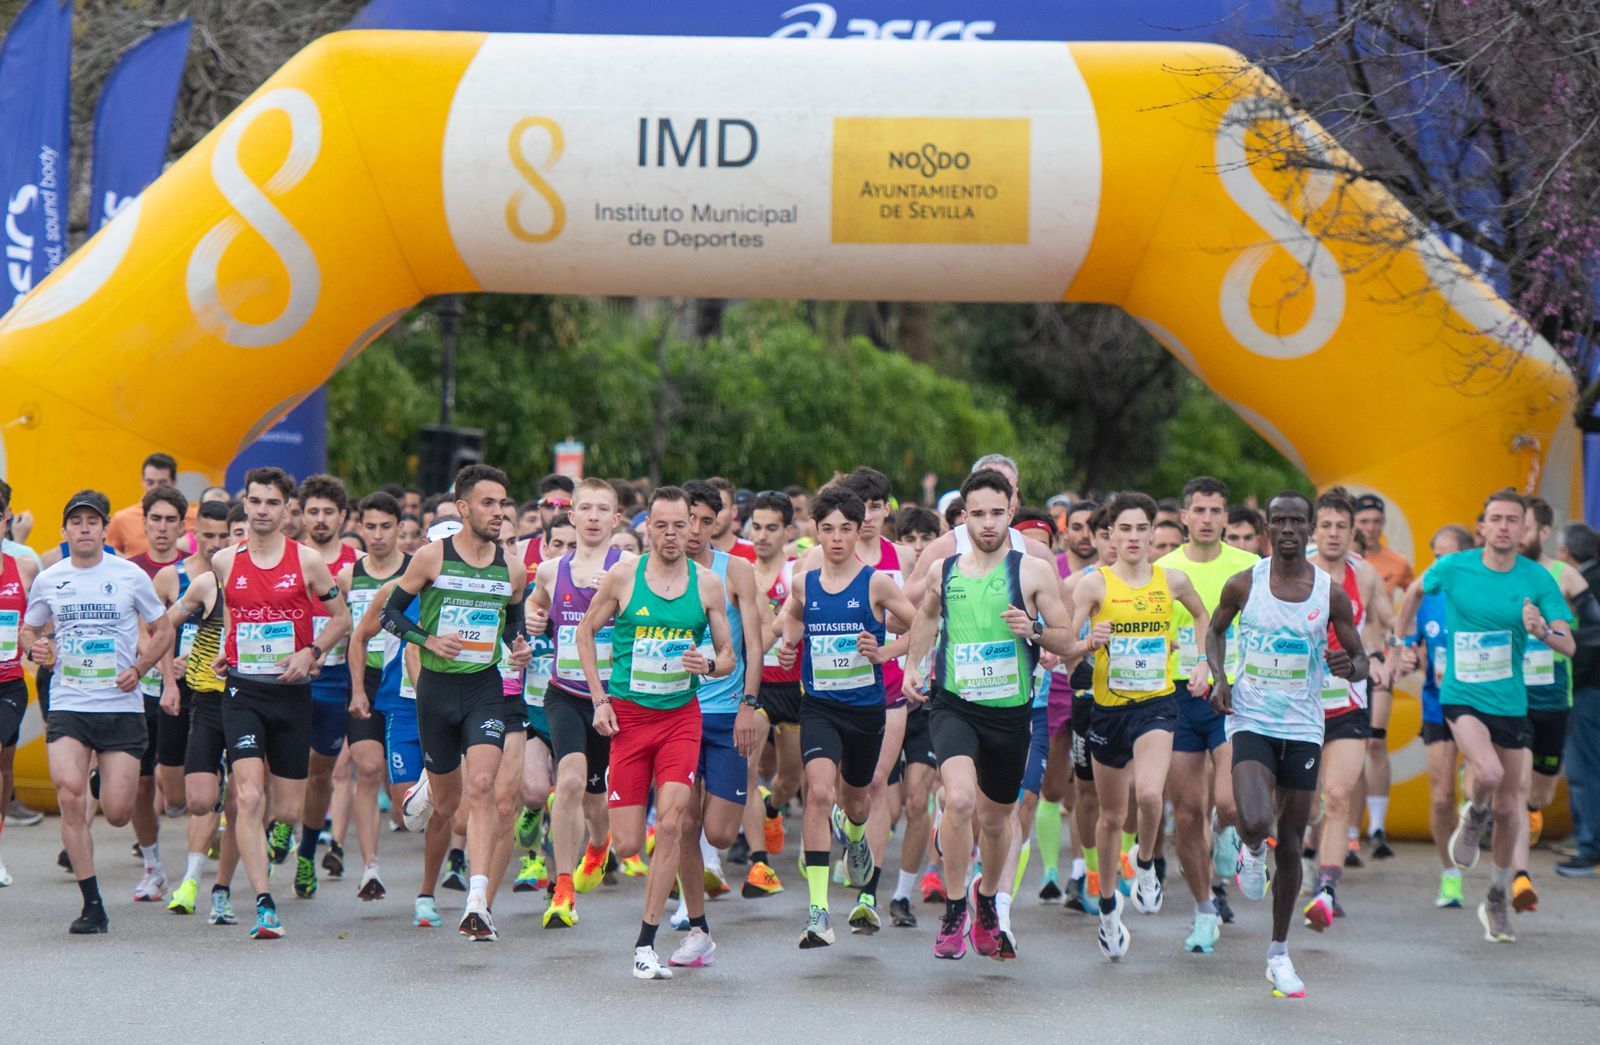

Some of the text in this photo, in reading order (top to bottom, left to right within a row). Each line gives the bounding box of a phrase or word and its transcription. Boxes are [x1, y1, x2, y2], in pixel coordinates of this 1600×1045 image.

[638, 117, 760, 168] IMD
[38, 144, 59, 189] body
[40, 189, 61, 242] sound
[595, 203, 798, 227] Instituto Municipal
[908, 201, 976, 220] SEVILLA
[5, 183, 39, 307] sics
[628, 229, 764, 250] de Deportes
[441, 607, 471, 626] 5K
[238, 624, 263, 640] 5K
[808, 622, 865, 632] TROTASIERRA
[62, 639, 87, 655] 5K
[261, 644, 272, 653] 18
[636, 641, 665, 657] 5K
[811, 637, 838, 655] 5K
[1111, 638, 1140, 656] 5K
[1248, 631, 1277, 654] 5K
[833, 658, 850, 667] 122
[955, 645, 984, 663] 5K
[1274, 658, 1279, 667] 1
[82, 659, 93, 668] 42
[662, 663, 668, 671] 4
[981, 667, 993, 676] 13
[1135, 659, 1147, 669] 96
[967, 676, 1008, 688] ALVARADO
